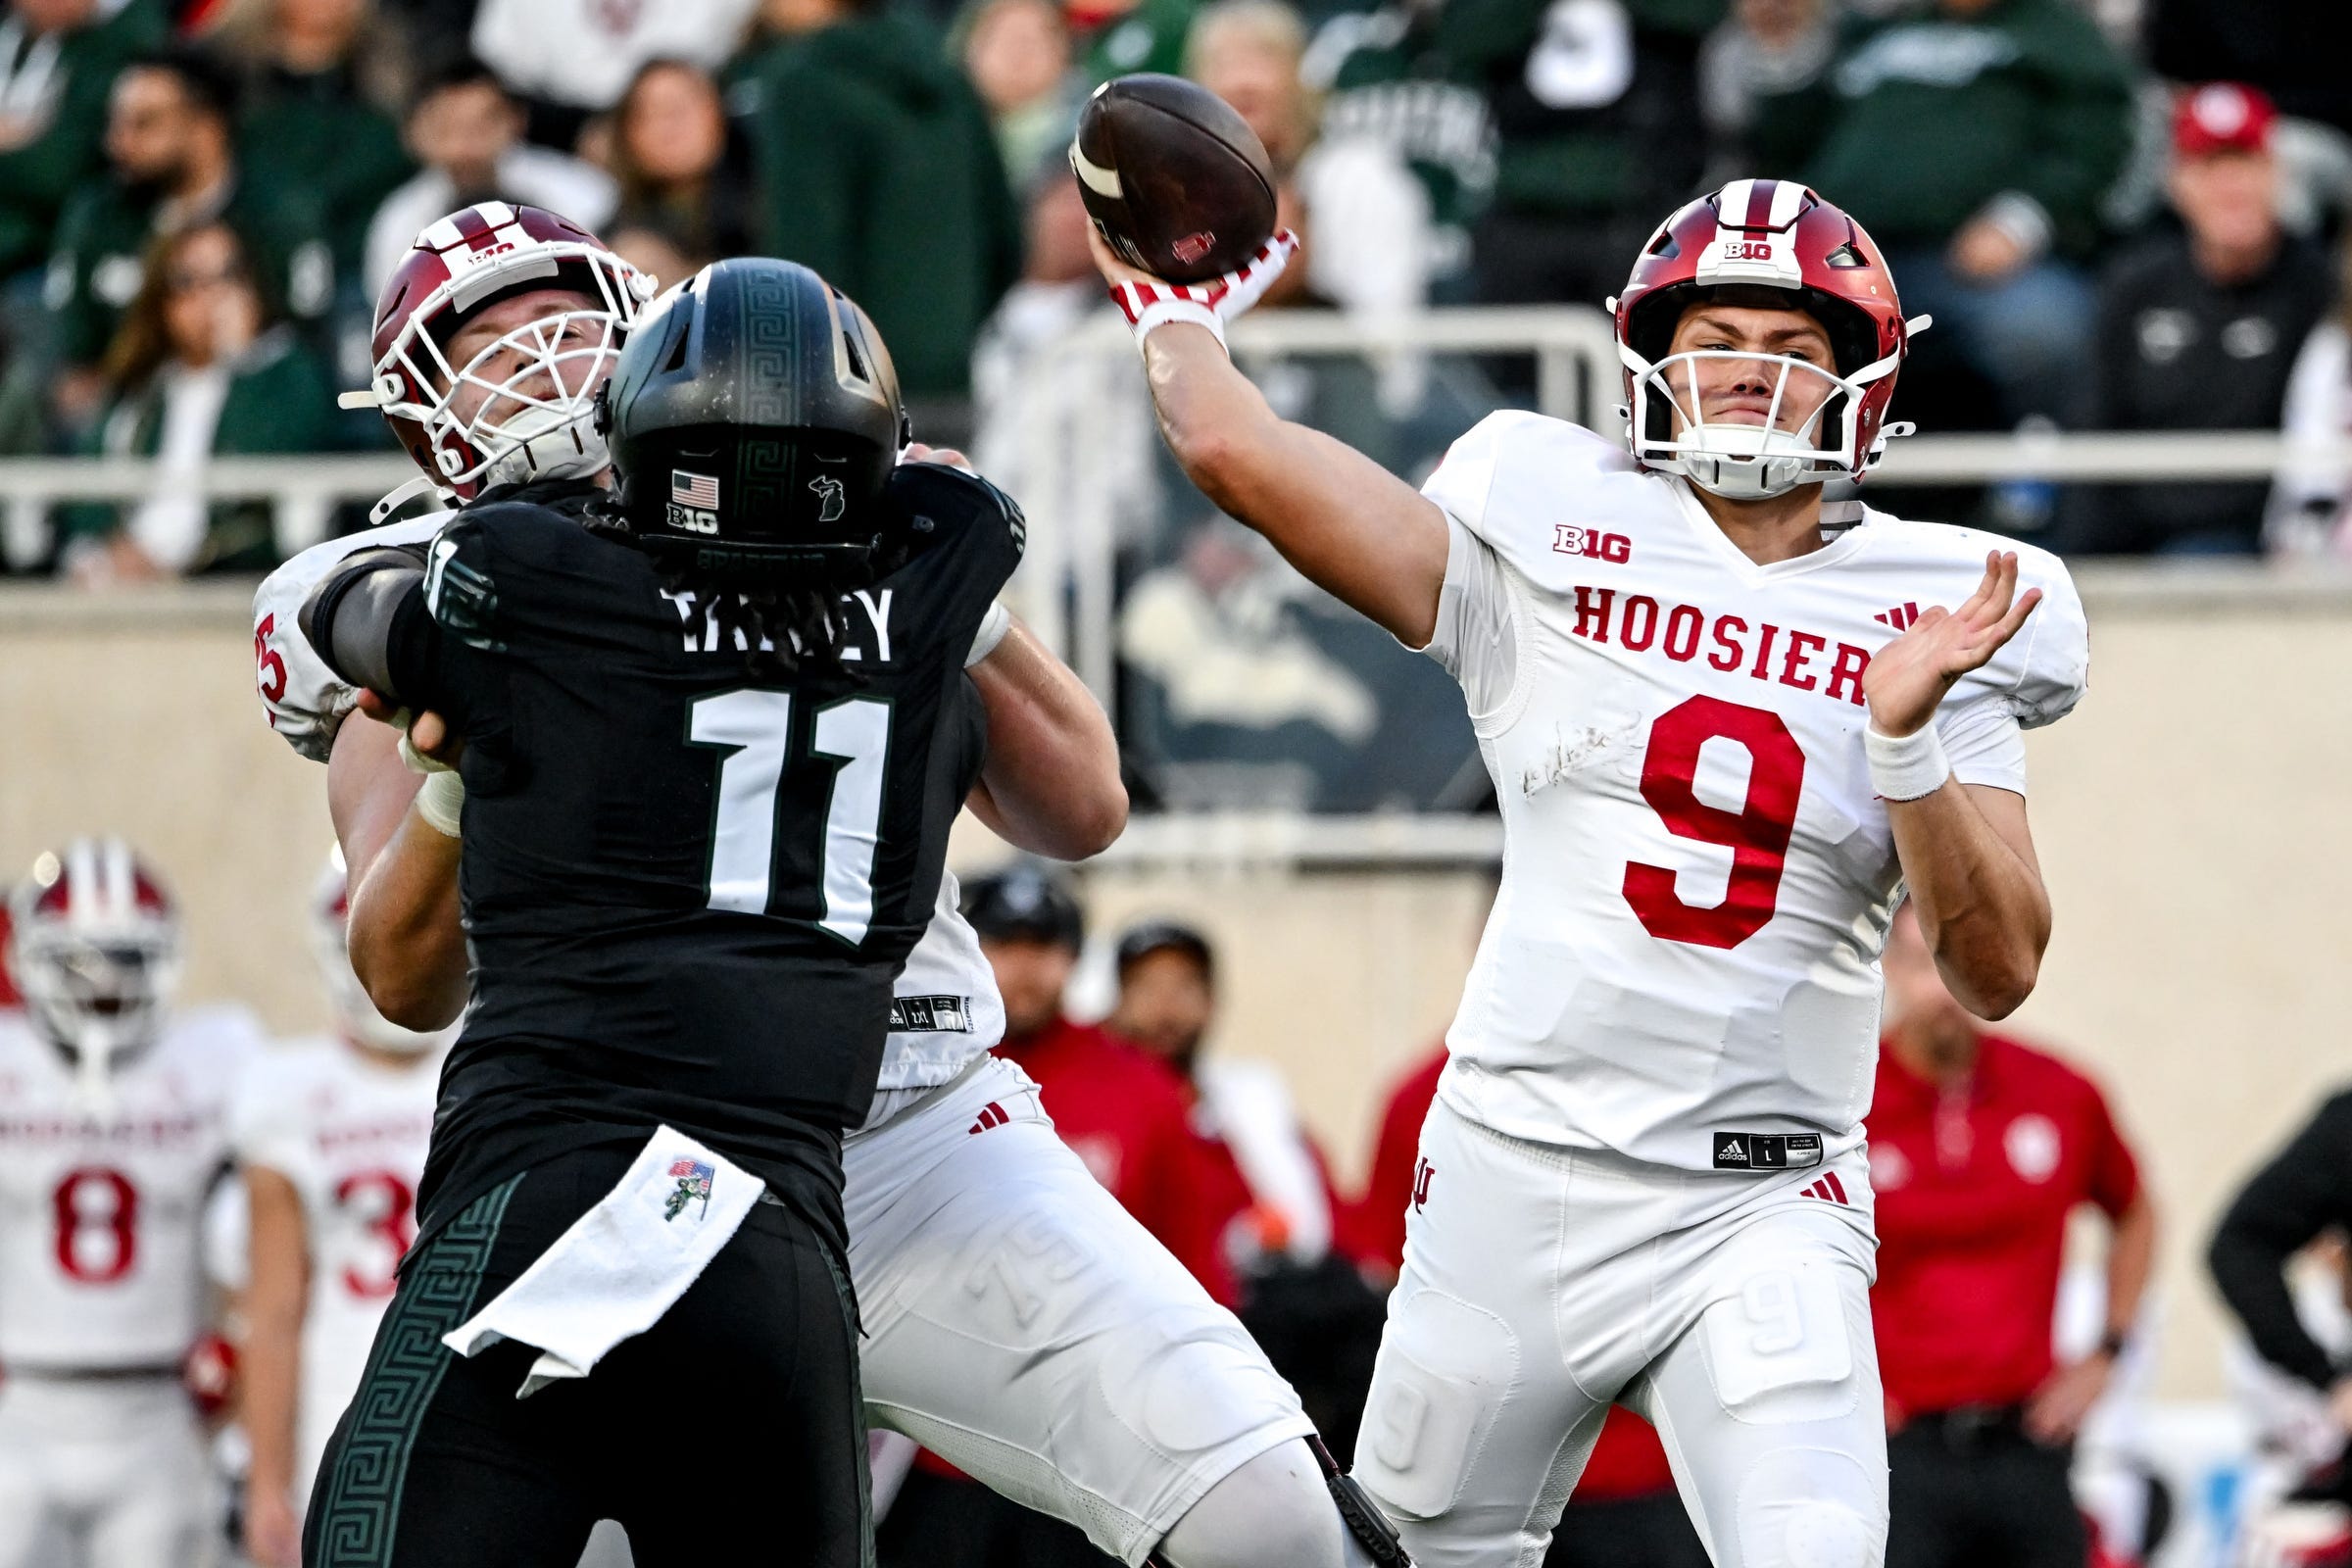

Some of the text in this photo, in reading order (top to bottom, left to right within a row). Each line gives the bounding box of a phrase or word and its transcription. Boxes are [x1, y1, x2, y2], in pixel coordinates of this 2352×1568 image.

[1572, 586, 1872, 707] HOOSIER
[683, 686, 896, 951] 11
[1622, 694, 1805, 950] 9
[911, 1010, 929, 1024] 2XL
[1718, 1152, 1747, 1161] adidas
[1765, 1150, 1772, 1161] L
[53, 1166, 140, 1287] 8
[333, 1170, 413, 1299] 3
